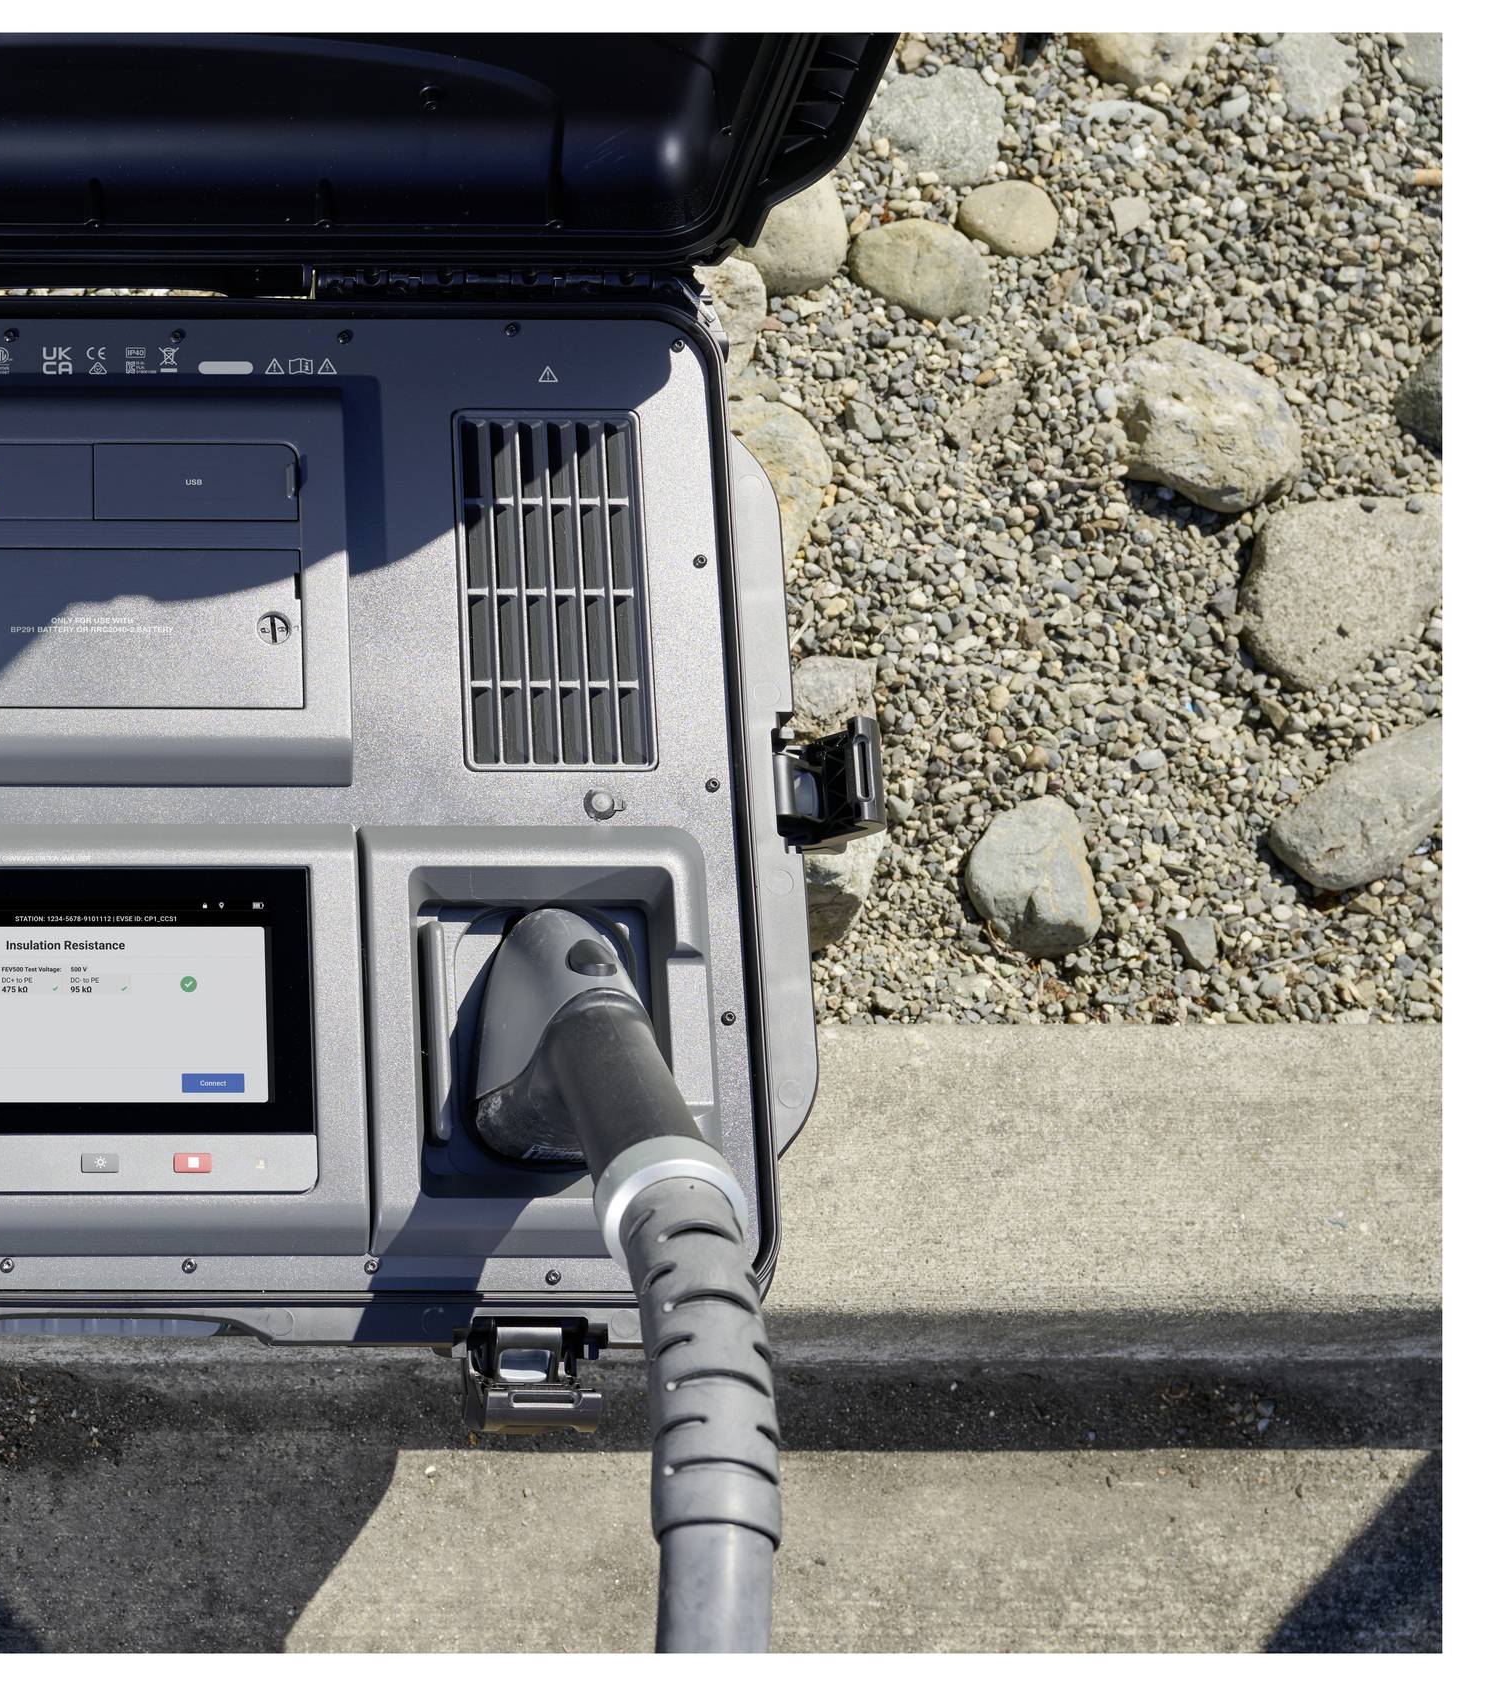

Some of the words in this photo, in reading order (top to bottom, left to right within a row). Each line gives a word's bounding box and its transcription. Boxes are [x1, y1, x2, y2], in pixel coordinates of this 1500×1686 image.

[43, 347, 72, 360] UK
[86, 347, 106, 360] CE
[43, 362, 72, 374] CA
[6, 941, 61, 950] Insulation
[64, 941, 125, 950] Resistance
